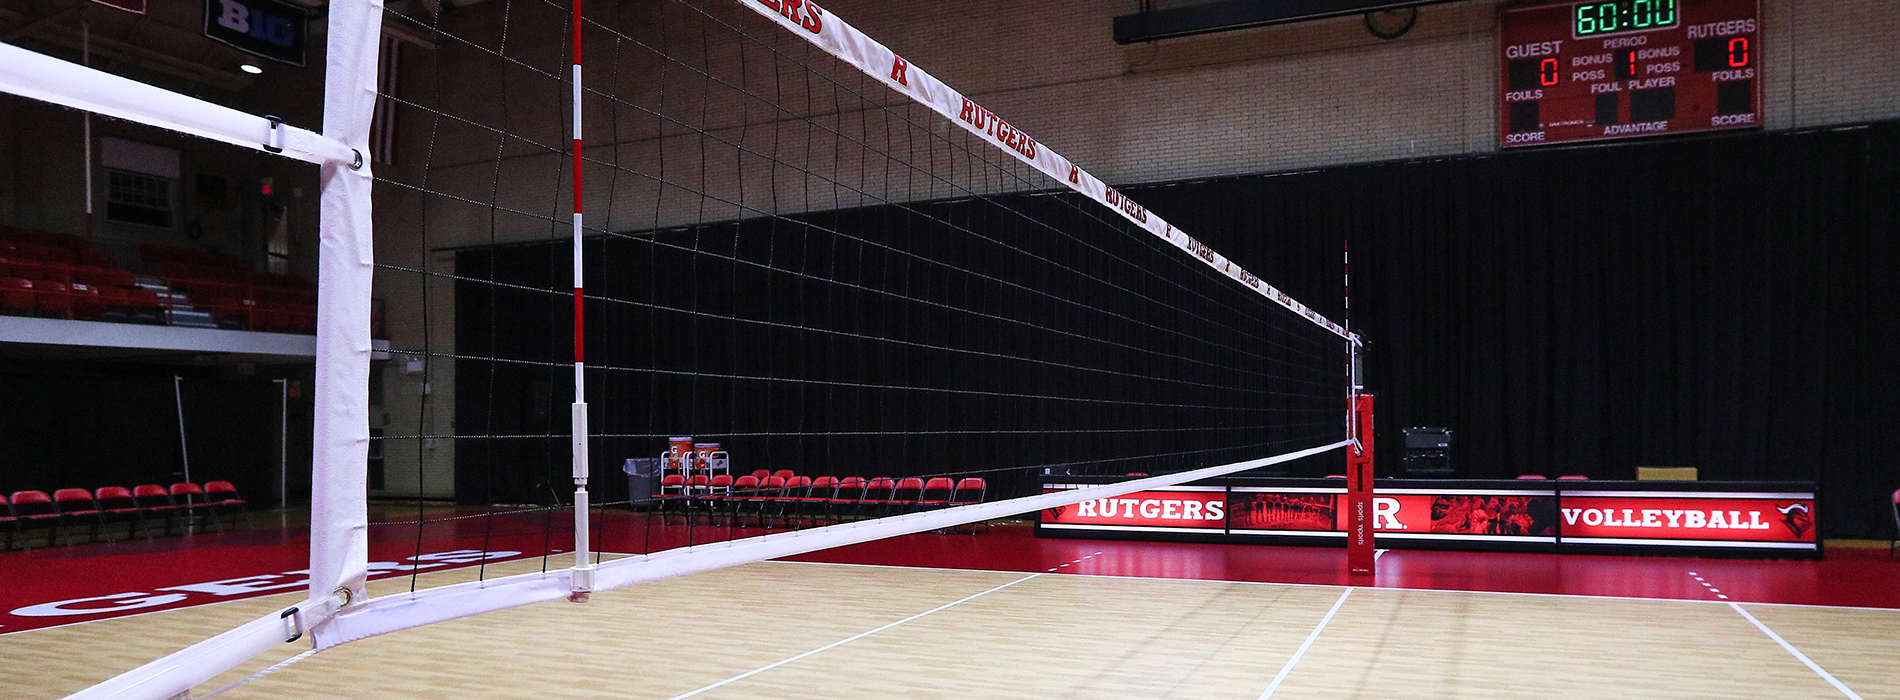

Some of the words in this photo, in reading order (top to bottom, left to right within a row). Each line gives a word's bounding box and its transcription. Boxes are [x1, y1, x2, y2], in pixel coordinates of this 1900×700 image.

[1577, 0, 1674, 34] 60:00
[1687, 19, 1756, 38] RUTGERS
[1506, 41, 1563, 59] GUEST
[1603, 36, 1648, 49] PERIOD
[1572, 54, 1613, 67] BONUS
[1638, 46, 1680, 60] BONUS
[1728, 37, 1748, 68] 0
[890, 53, 908, 86] R
[1540, 58, 1559, 86] 0
[1629, 51, 1636, 76] 1
[1646, 62, 1681, 74] POSS
[1572, 70, 1605, 82] POSS
[1712, 69, 1755, 81] FOULS
[1591, 80, 1622, 93] FOUL
[1628, 77, 1676, 90] PLAYER
[1506, 89, 1543, 101] FOULS
[1603, 121, 1668, 135] ADVANTAGE
[1711, 113, 1755, 126] SCORE
[959, 97, 1036, 160] RUTGERS
[1506, 131, 1545, 143] SCORE
[1068, 163, 1079, 184] R
[1105, 185, 1147, 224] RUTGERS
[671, 446, 678, 454] G
[1077, 498, 1225, 521] RUTGERS
[1561, 508, 1769, 528] VOLLEYBALL
